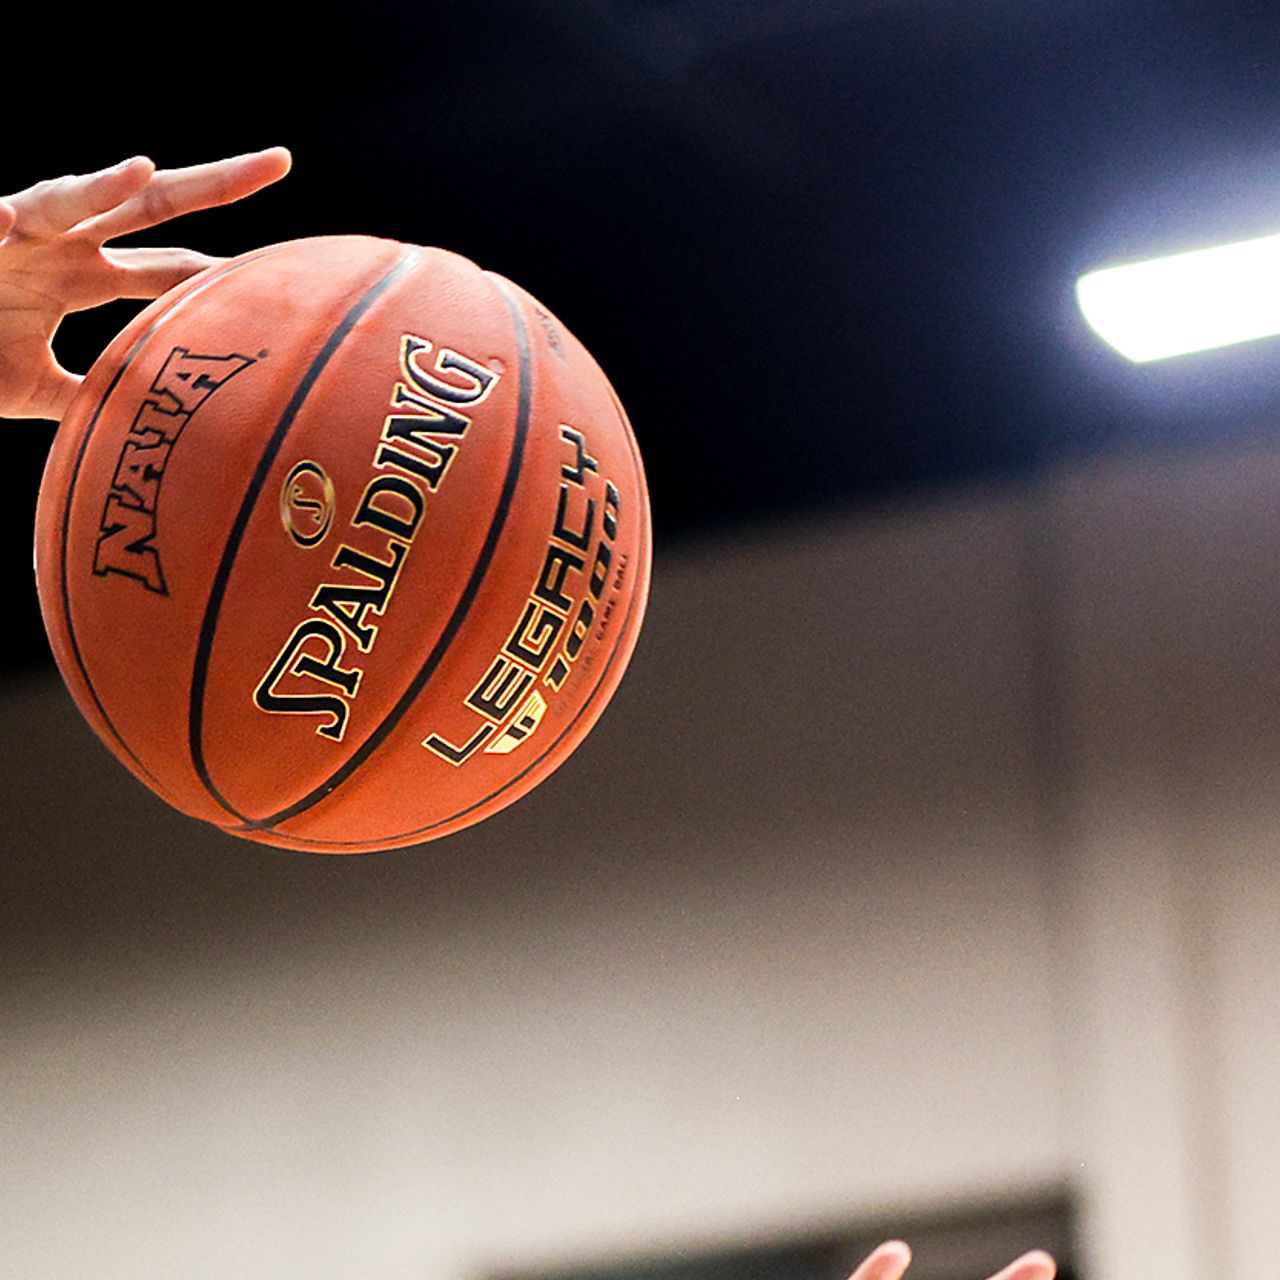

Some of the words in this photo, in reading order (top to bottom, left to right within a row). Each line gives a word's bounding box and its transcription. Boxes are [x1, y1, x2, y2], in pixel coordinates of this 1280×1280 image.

[92, 346, 258, 596] NAIA
[252, 333, 501, 741] SPALDING
[421, 424, 599, 766] LEGACY
